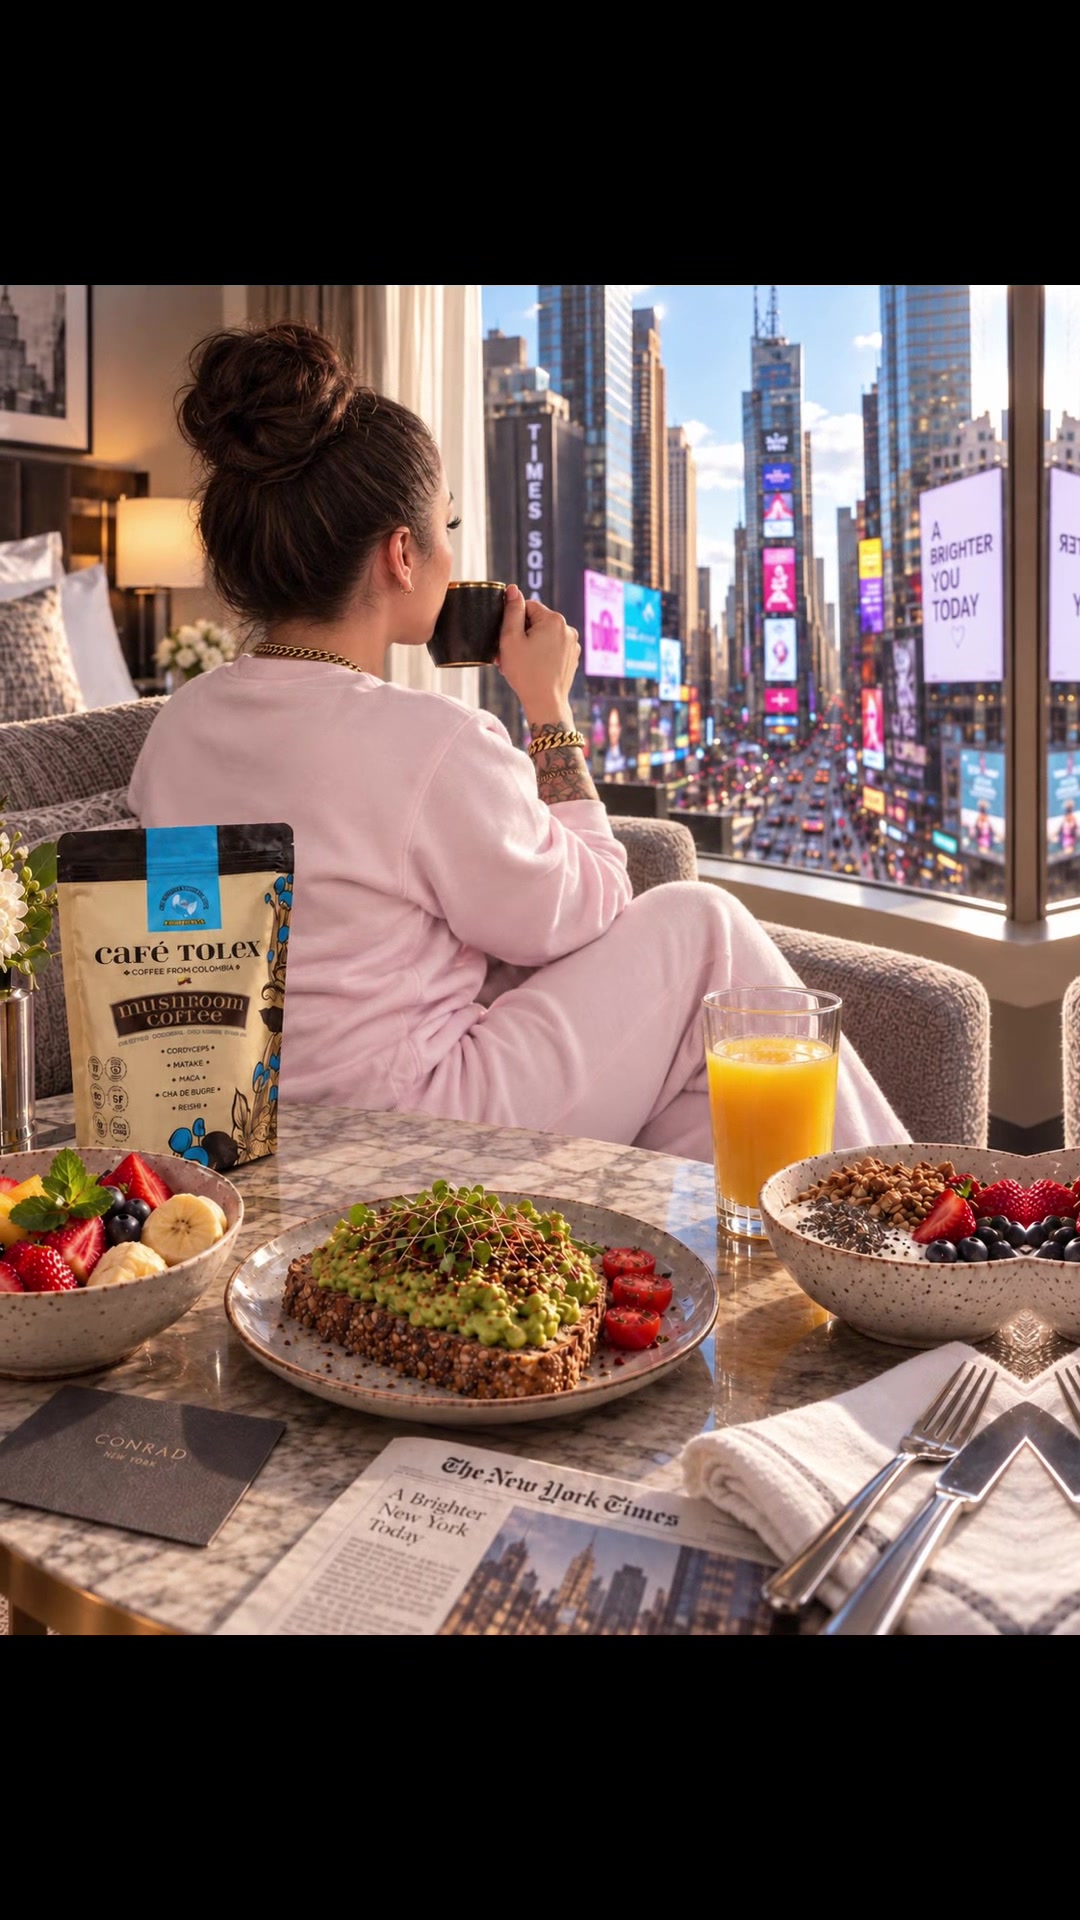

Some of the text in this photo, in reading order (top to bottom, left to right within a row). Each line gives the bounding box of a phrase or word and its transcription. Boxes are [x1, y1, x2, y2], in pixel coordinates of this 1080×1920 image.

[525, 423, 544, 520] TIMES
[931, 521, 942, 542] A
[930, 533, 993, 566] BRIGHTER
[931, 567, 960, 593] YOU
[932, 593, 979, 622] TODAY
[132, 964, 234, 976] COFFEE FROM COLOMBIA
[166, 1045, 210, 1055] CORDYCEPS
[173, 1060, 204, 1069] MATAKE
[162, 1087, 216, 1098] CHA DE BUGRE
[178, 1103, 202, 1111] REISHI
[95, 1433, 187, 1460] CONRAD
[103, 1451, 158, 1467] NEW YORK
[388, 1488, 488, 1521] A Brighter
[441, 1456, 485, 1480] The
[484, 1467, 539, 1493] New
[538, 1480, 600, 1509] York
[603, 1494, 680, 1527] Times
[368, 1518, 425, 1547] Today
[378, 1502, 470, 1538] New York
